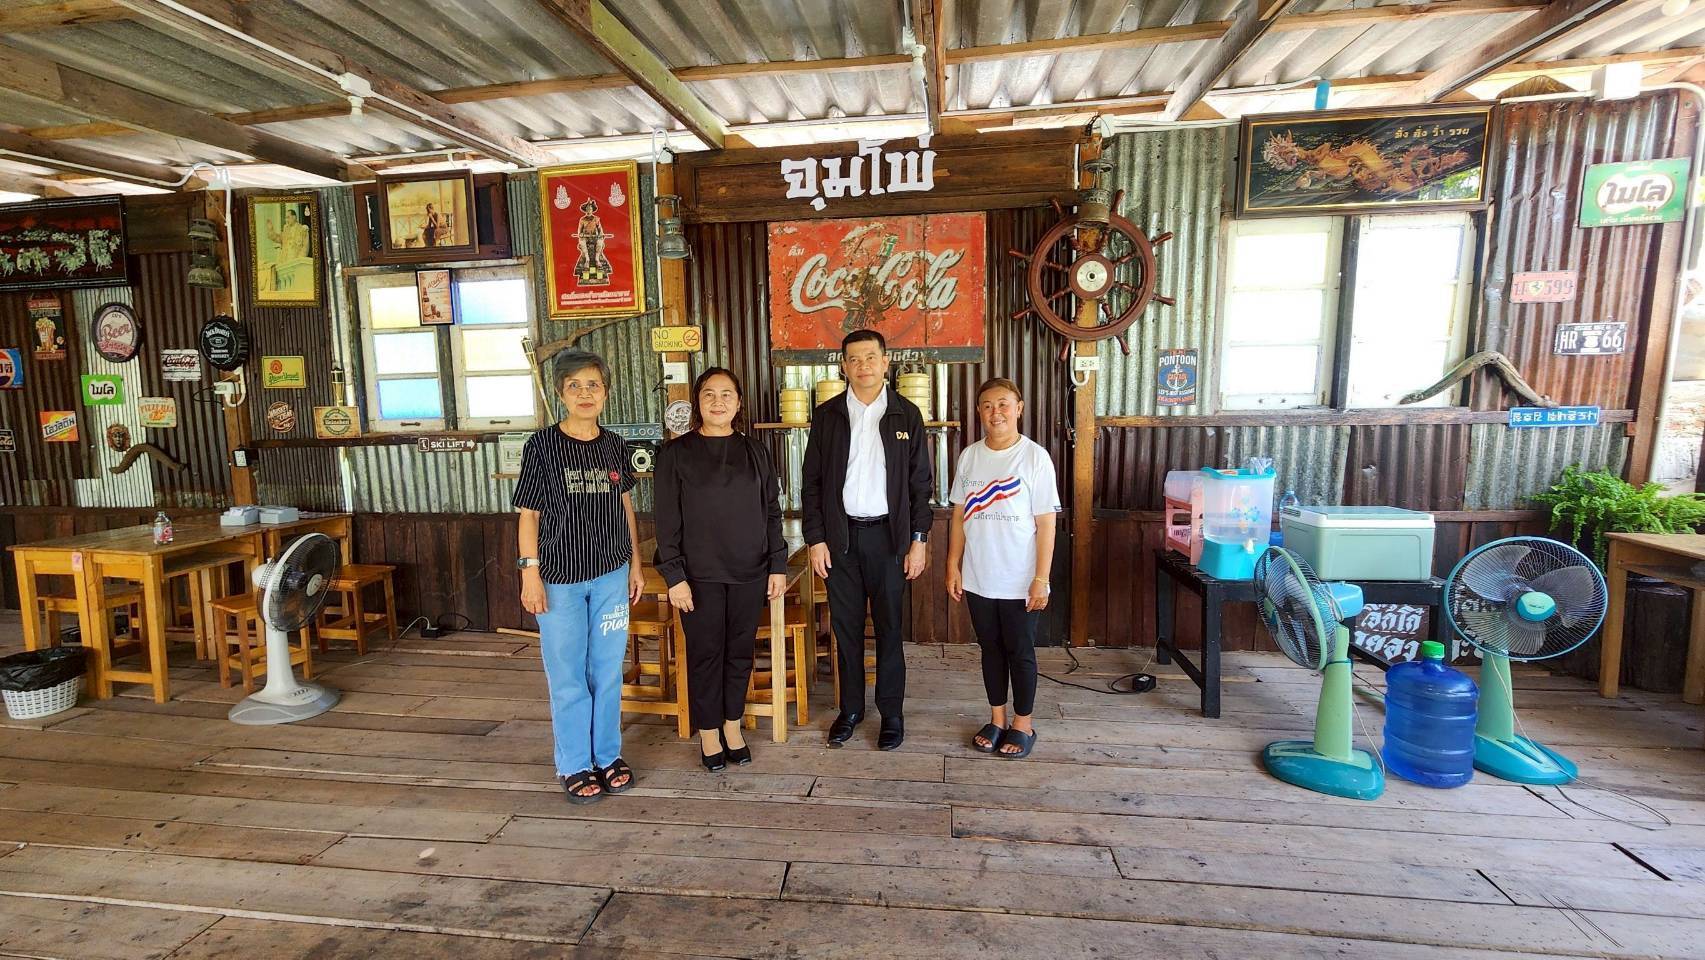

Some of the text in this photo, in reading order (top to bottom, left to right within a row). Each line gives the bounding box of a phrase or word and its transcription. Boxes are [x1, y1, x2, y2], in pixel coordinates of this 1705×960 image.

[1603, 179, 1668, 205] ไมโล
[654, 329, 669, 340] NO
[1558, 328, 1623, 350] HR 66
[655, 340, 683, 349] SMOKING
[1159, 354, 1197, 368] PONTOON
[90, 383, 115, 395] ไมโล
[631, 428, 655, 436] LOO
[430, 440, 466, 449] SKI LIFT
